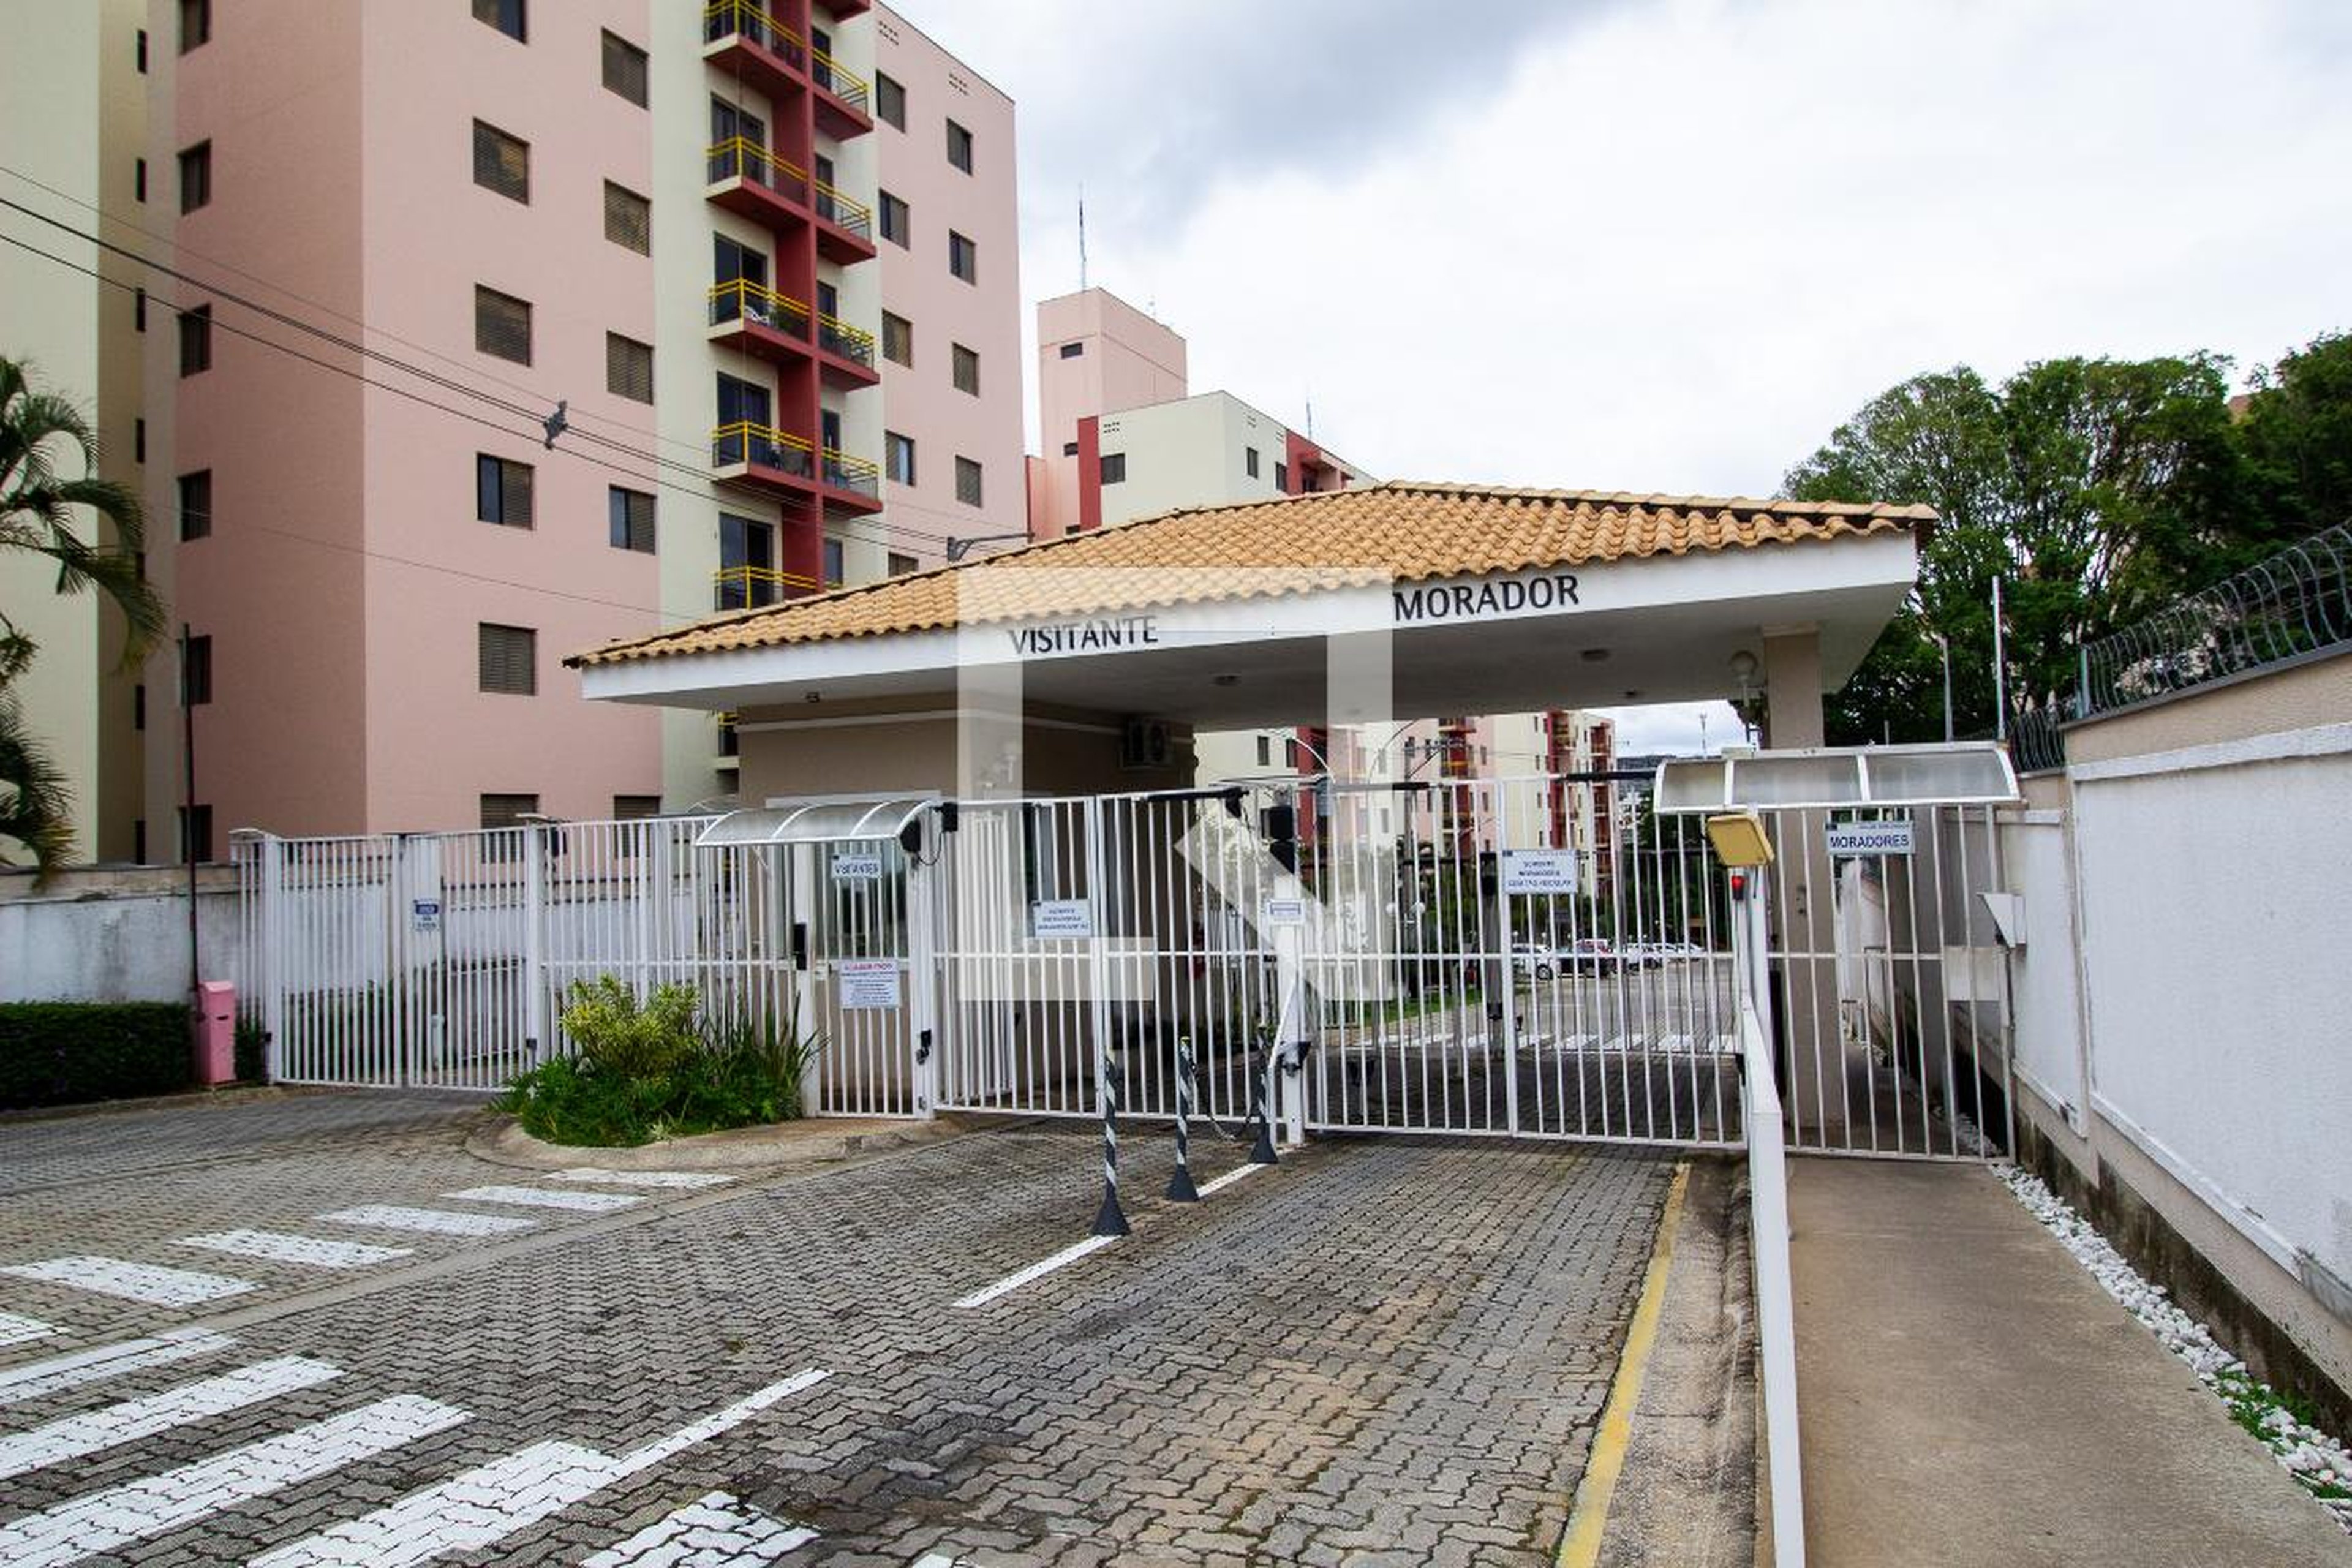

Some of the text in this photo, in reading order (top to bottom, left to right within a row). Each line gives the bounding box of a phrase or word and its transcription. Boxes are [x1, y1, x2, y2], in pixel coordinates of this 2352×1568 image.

[1392, 575, 1579, 621] MORADOR
[1007, 615, 1158, 654] VISITANTE
[1830, 834, 1910, 848] MORADORES
